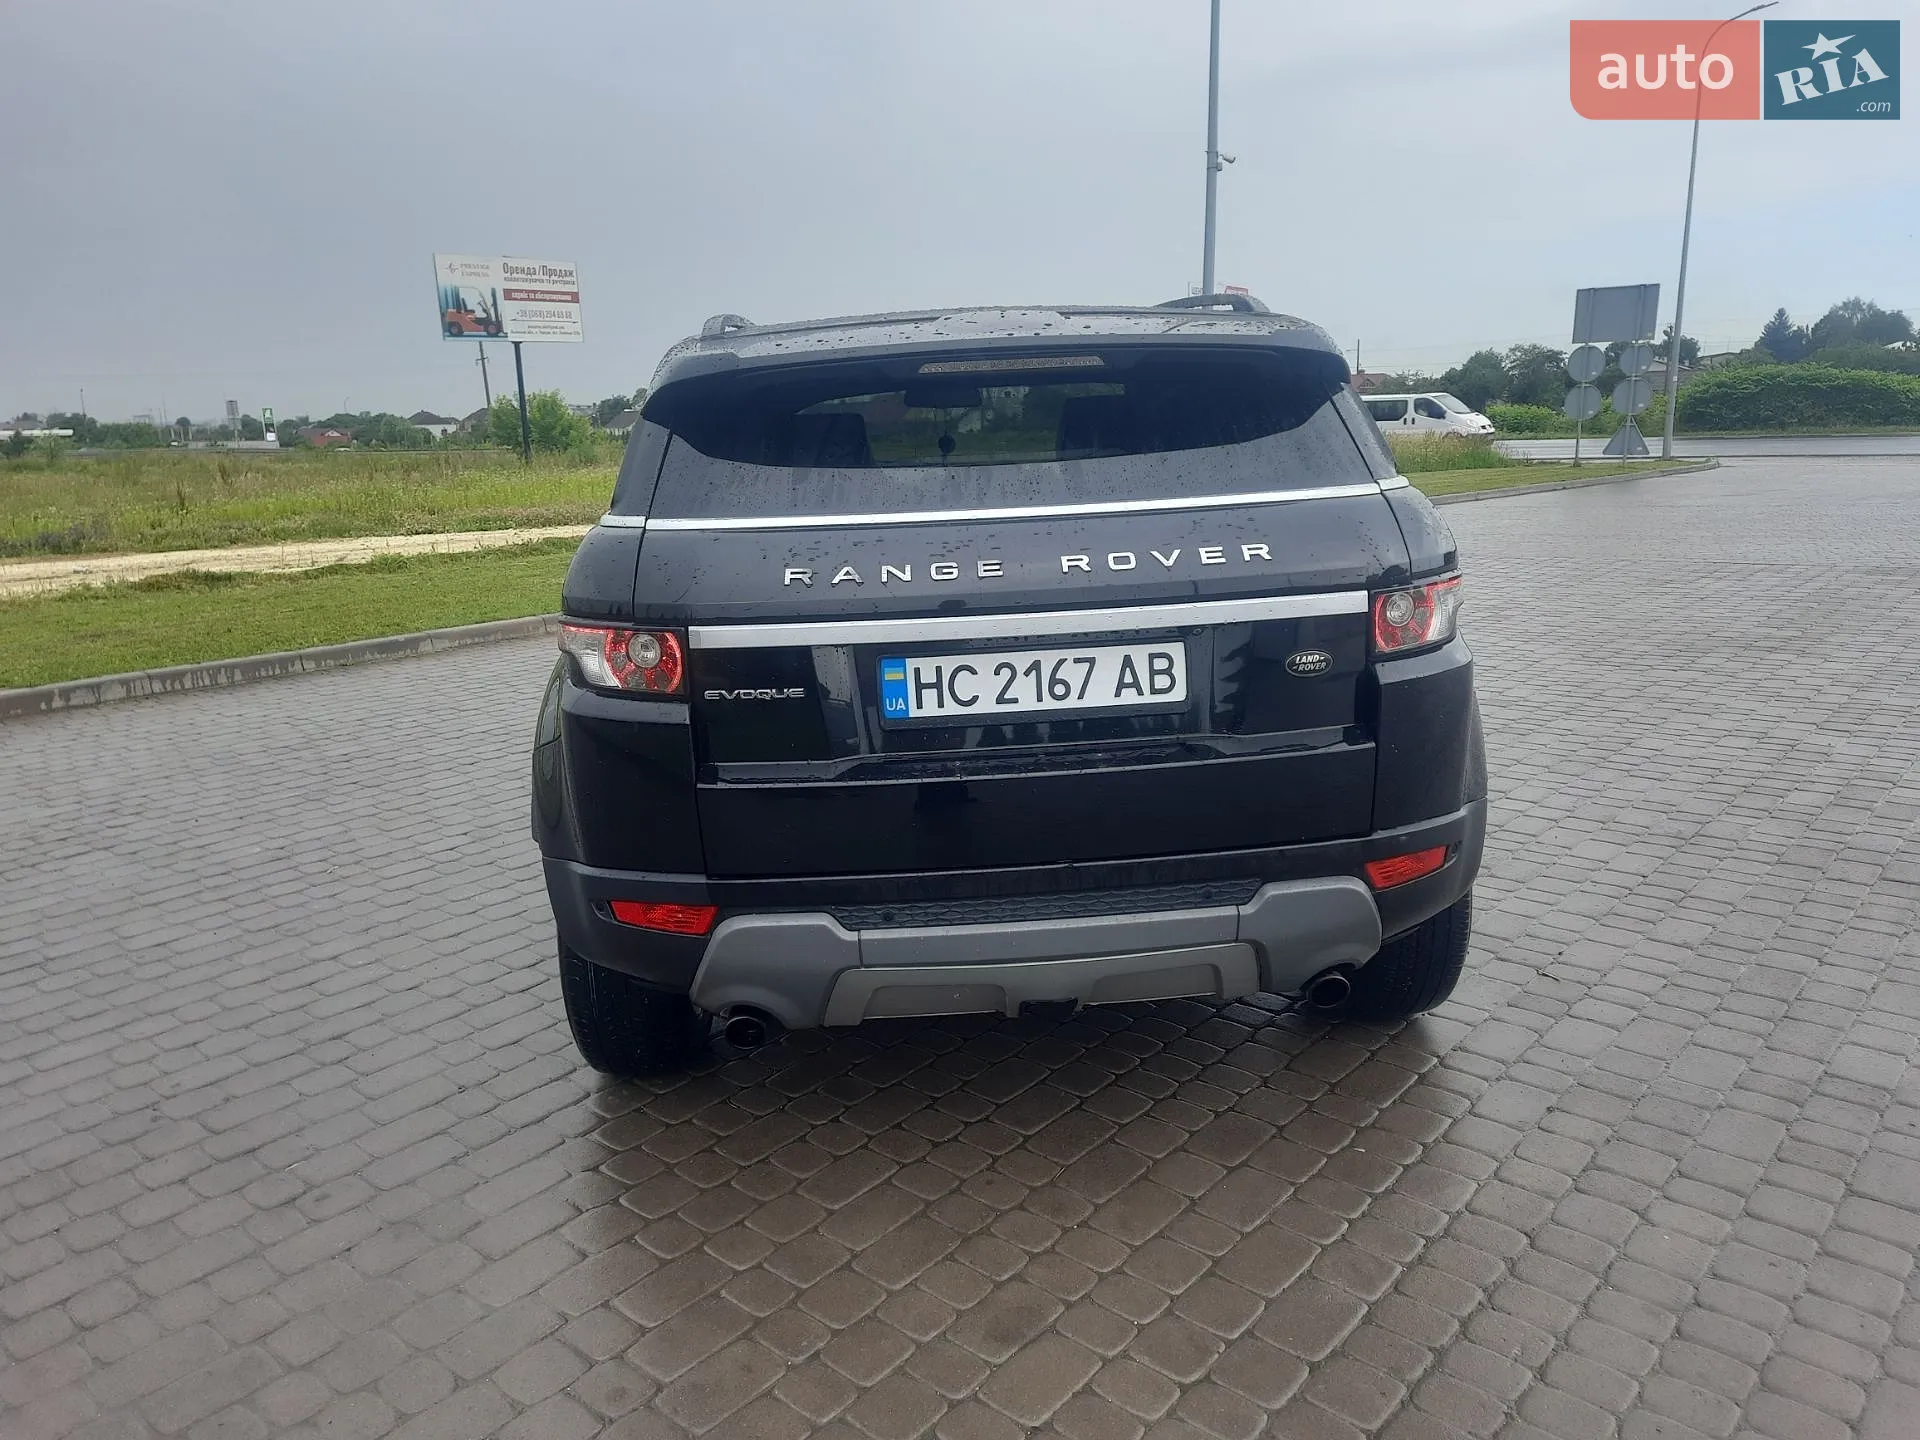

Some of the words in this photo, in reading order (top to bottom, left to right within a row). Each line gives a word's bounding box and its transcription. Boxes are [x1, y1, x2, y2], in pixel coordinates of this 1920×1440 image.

[784, 559, 1004, 587] RANGE
[1061, 543, 1273, 573] ROVER
[1295, 654, 1320, 664] LAND
[1297, 662, 1327, 672] ROVER
[913, 664, 980, 710] HC
[993, 656, 1097, 705] 2167
[1114, 652, 1178, 698] AB
[704, 688, 805, 700] EVOQUE
[886, 698, 906, 711] UA
